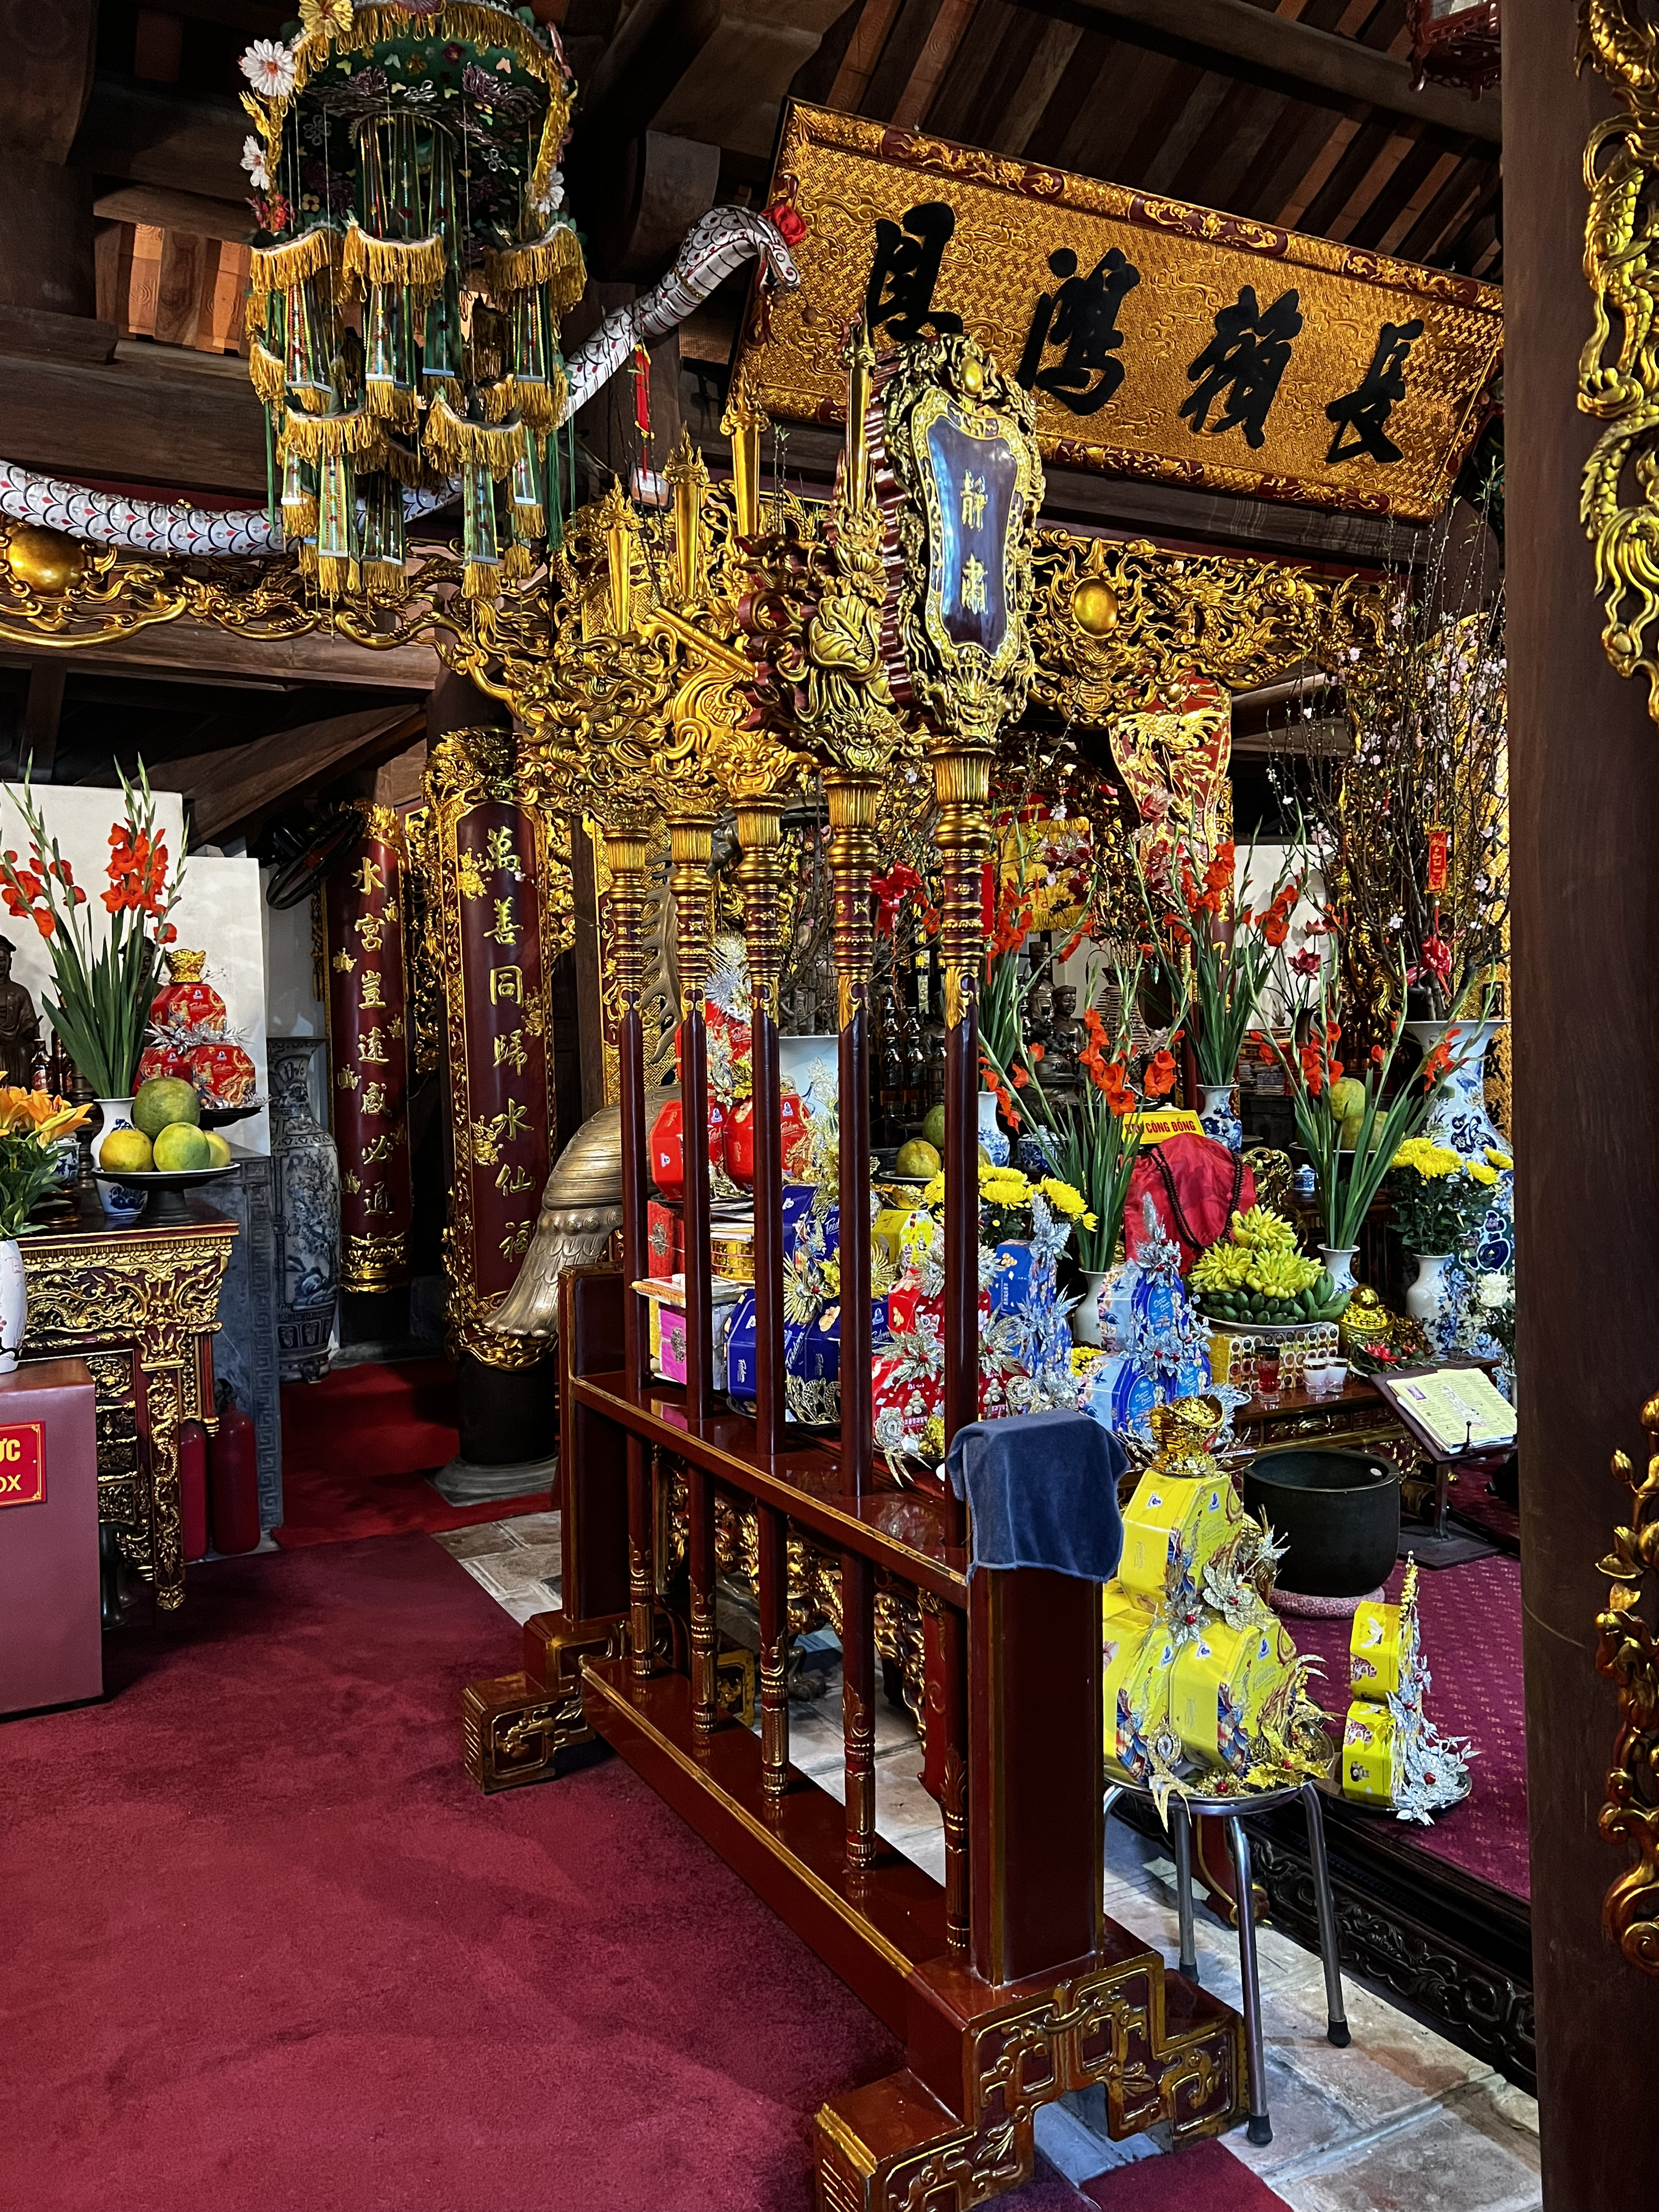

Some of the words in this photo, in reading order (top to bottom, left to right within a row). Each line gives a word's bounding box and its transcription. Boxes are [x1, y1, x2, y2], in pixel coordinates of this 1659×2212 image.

[351, 857, 395, 1218] 水宮豈遠感必通
[1145, 1120, 1171, 1134] CÔNG
[824, 1217, 840, 1235] Feed
